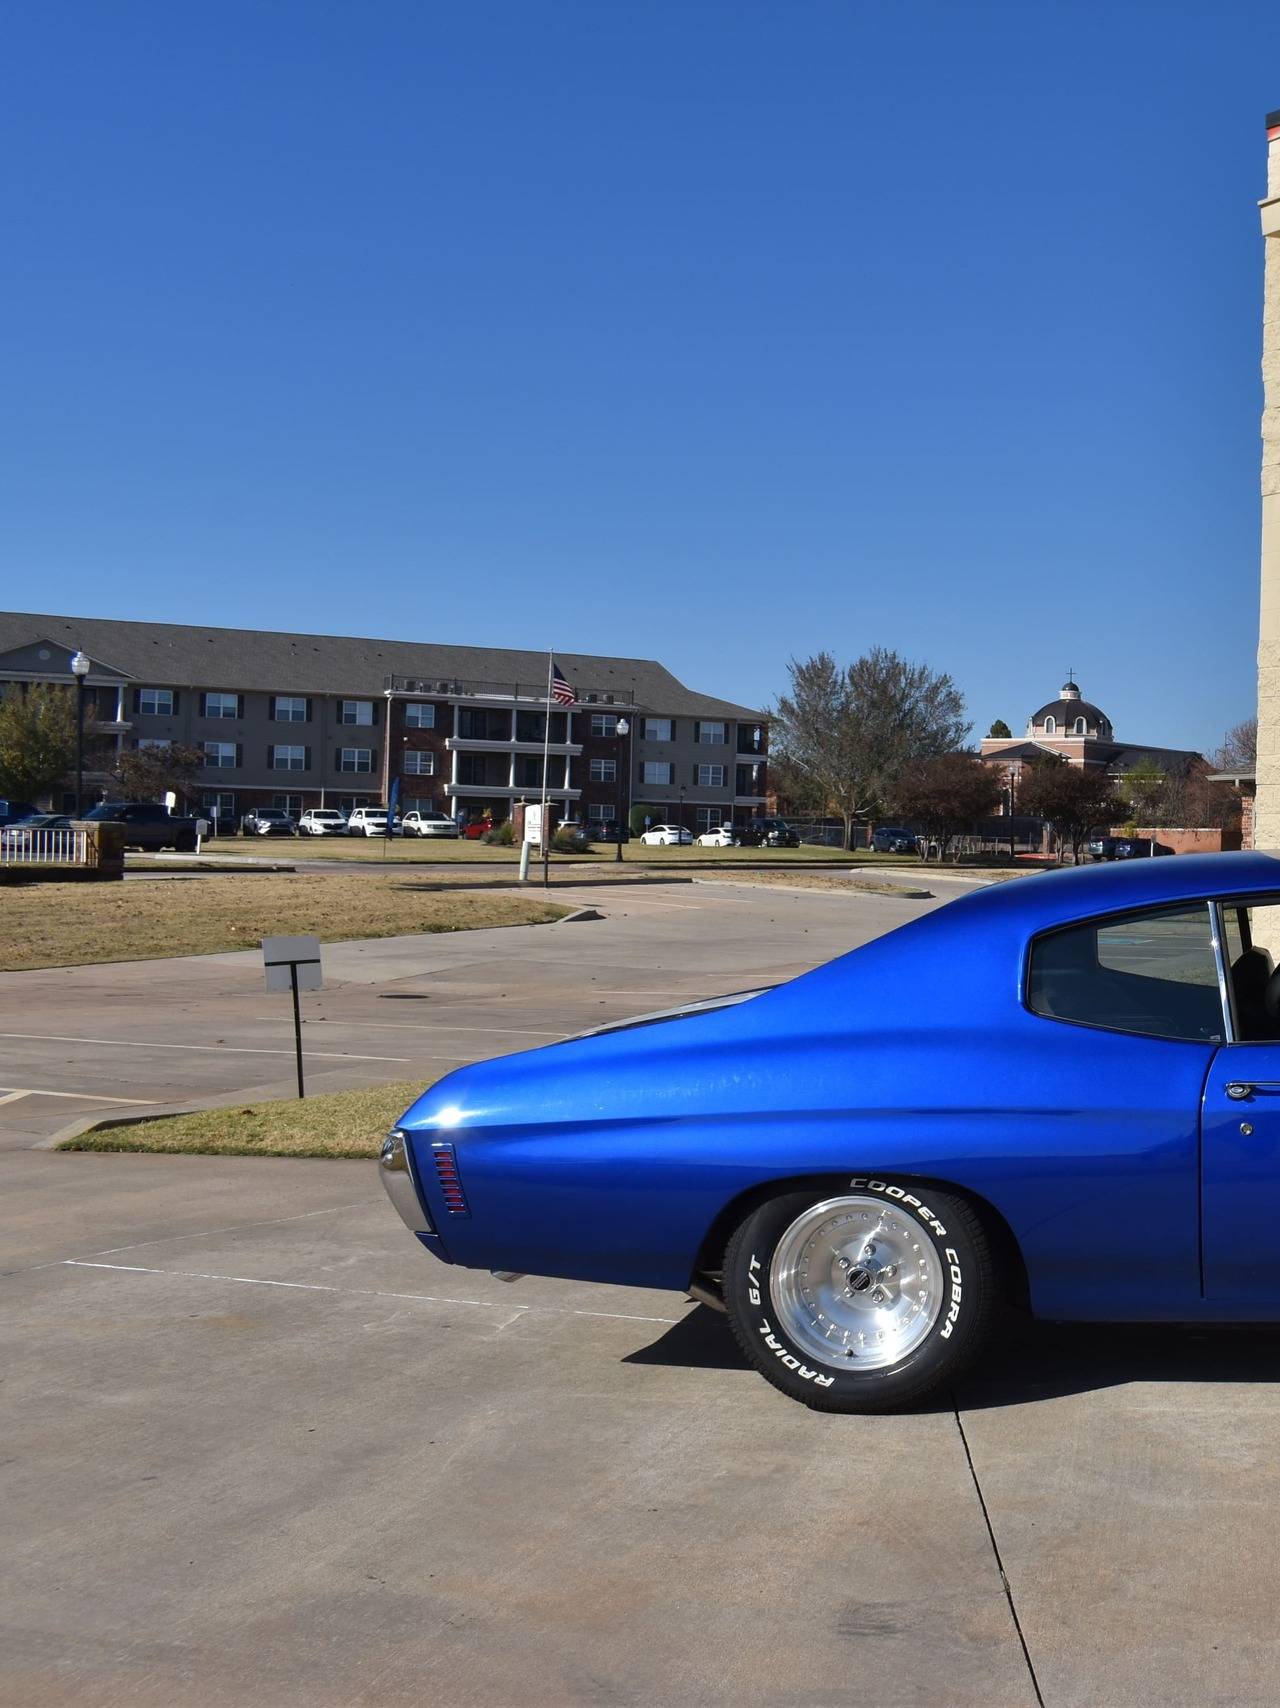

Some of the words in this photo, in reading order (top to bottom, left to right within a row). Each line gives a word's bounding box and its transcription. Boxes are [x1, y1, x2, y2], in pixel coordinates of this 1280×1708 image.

[748, 1254, 762, 1306] G/T
[850, 1177, 948, 1237] COOPER
[940, 1247, 962, 1340] COBRA
[759, 1318, 836, 1388] RADIAL
